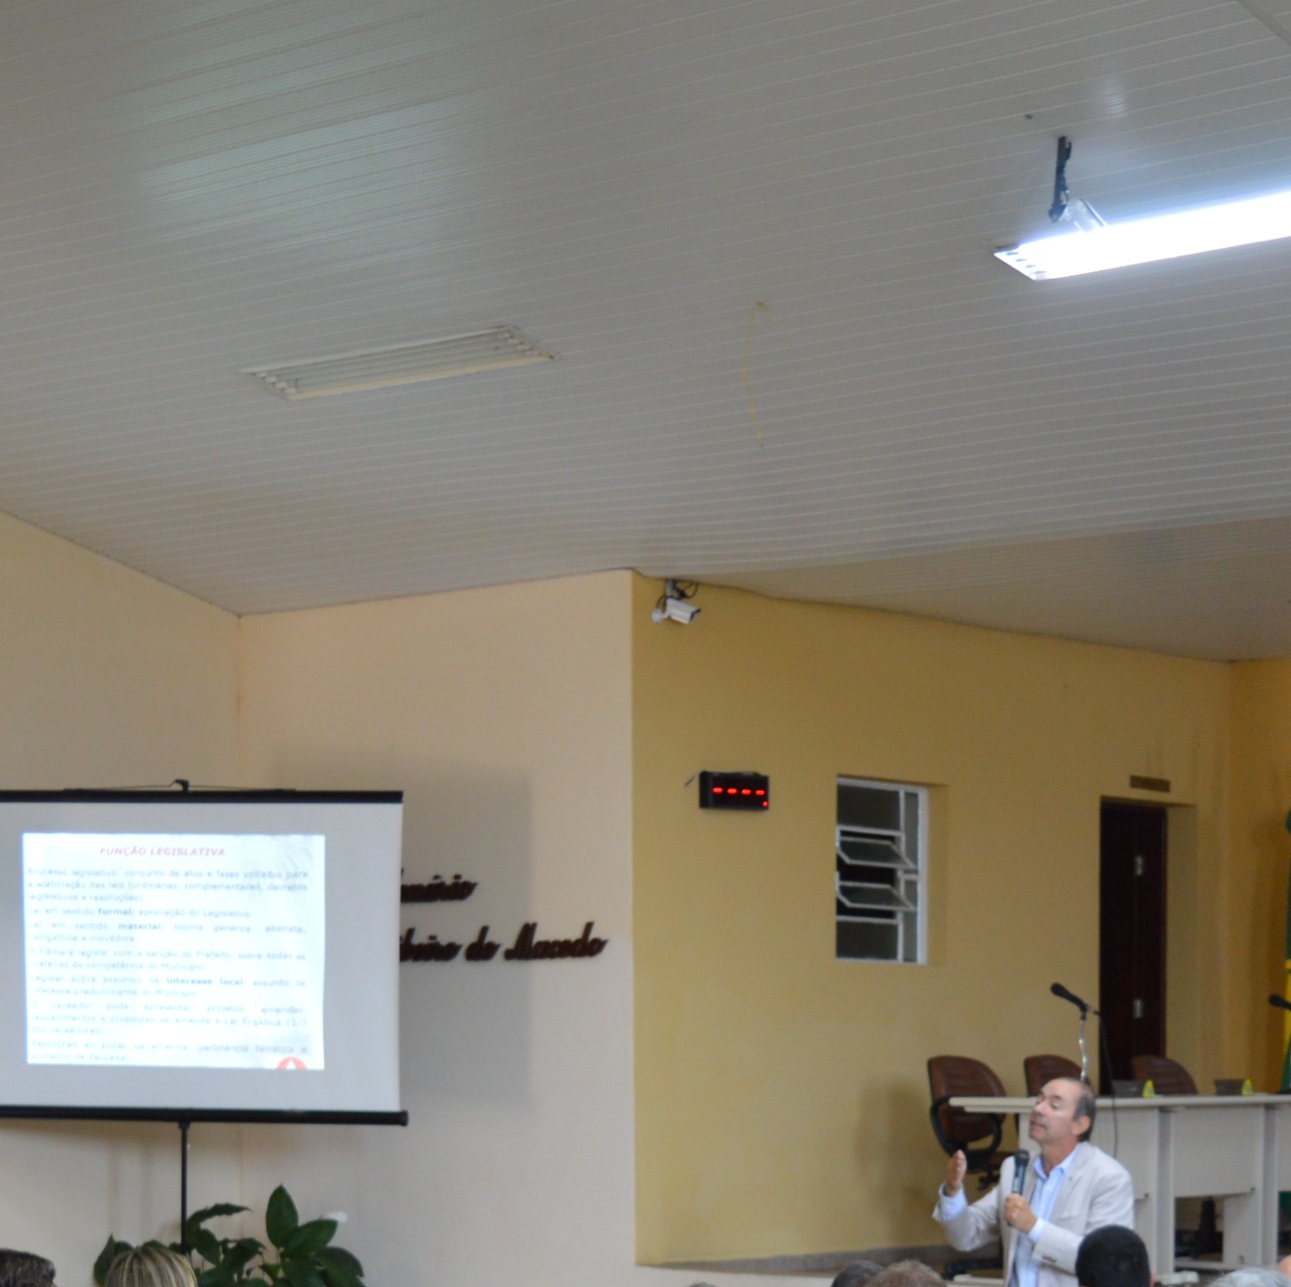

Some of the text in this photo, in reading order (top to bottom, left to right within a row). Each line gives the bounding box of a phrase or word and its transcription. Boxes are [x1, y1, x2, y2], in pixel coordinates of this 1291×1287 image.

[99, 845, 227, 858] FUNÇÃO LEGISLATIVA
[504, 922, 608, 961] Macedo
